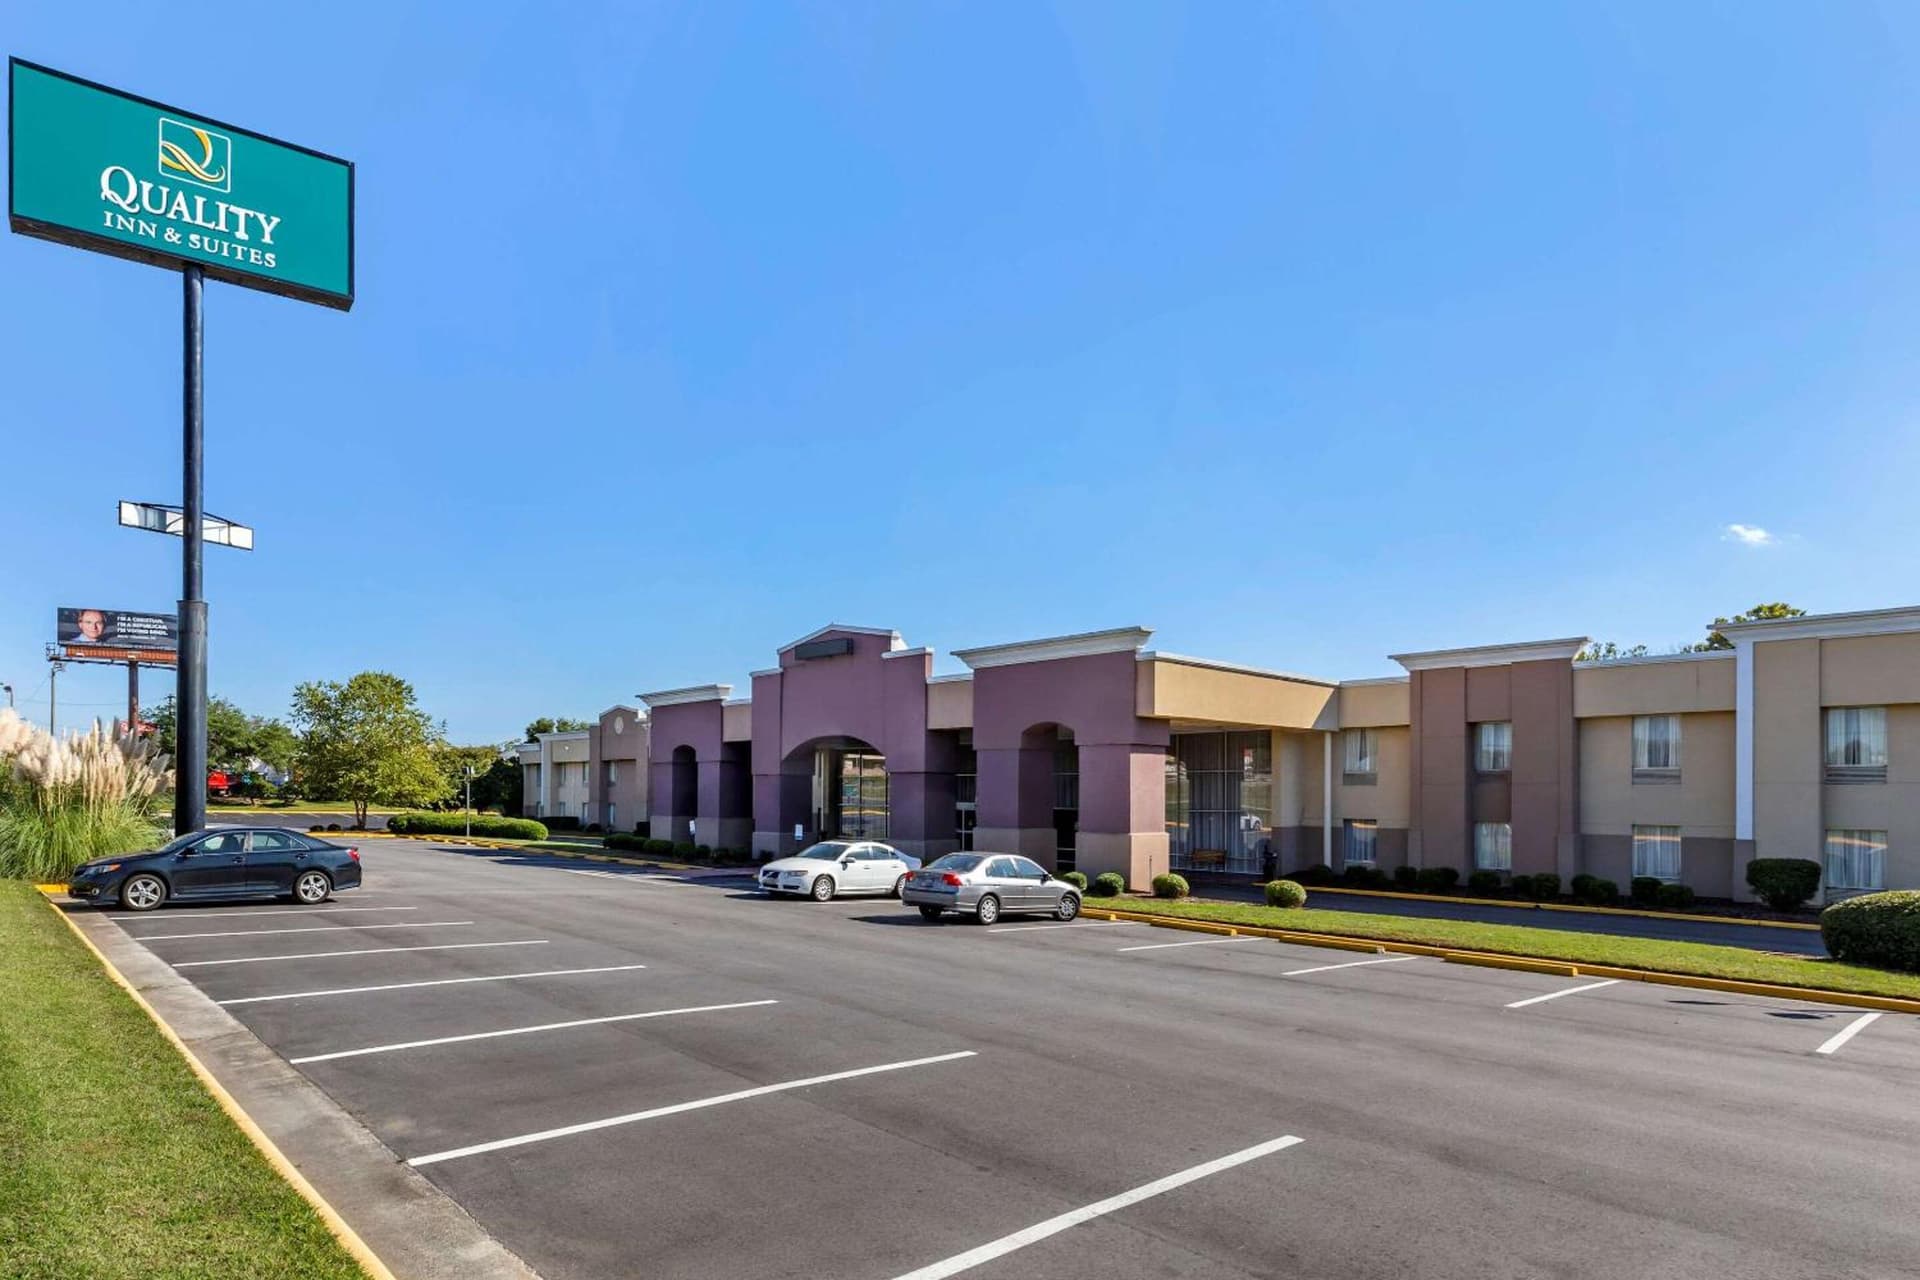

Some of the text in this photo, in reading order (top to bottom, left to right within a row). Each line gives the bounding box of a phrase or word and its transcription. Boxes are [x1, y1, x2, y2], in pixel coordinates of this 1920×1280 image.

[100, 165, 281, 245] QUALITY
[104, 211, 277, 269] INN & SUITES
